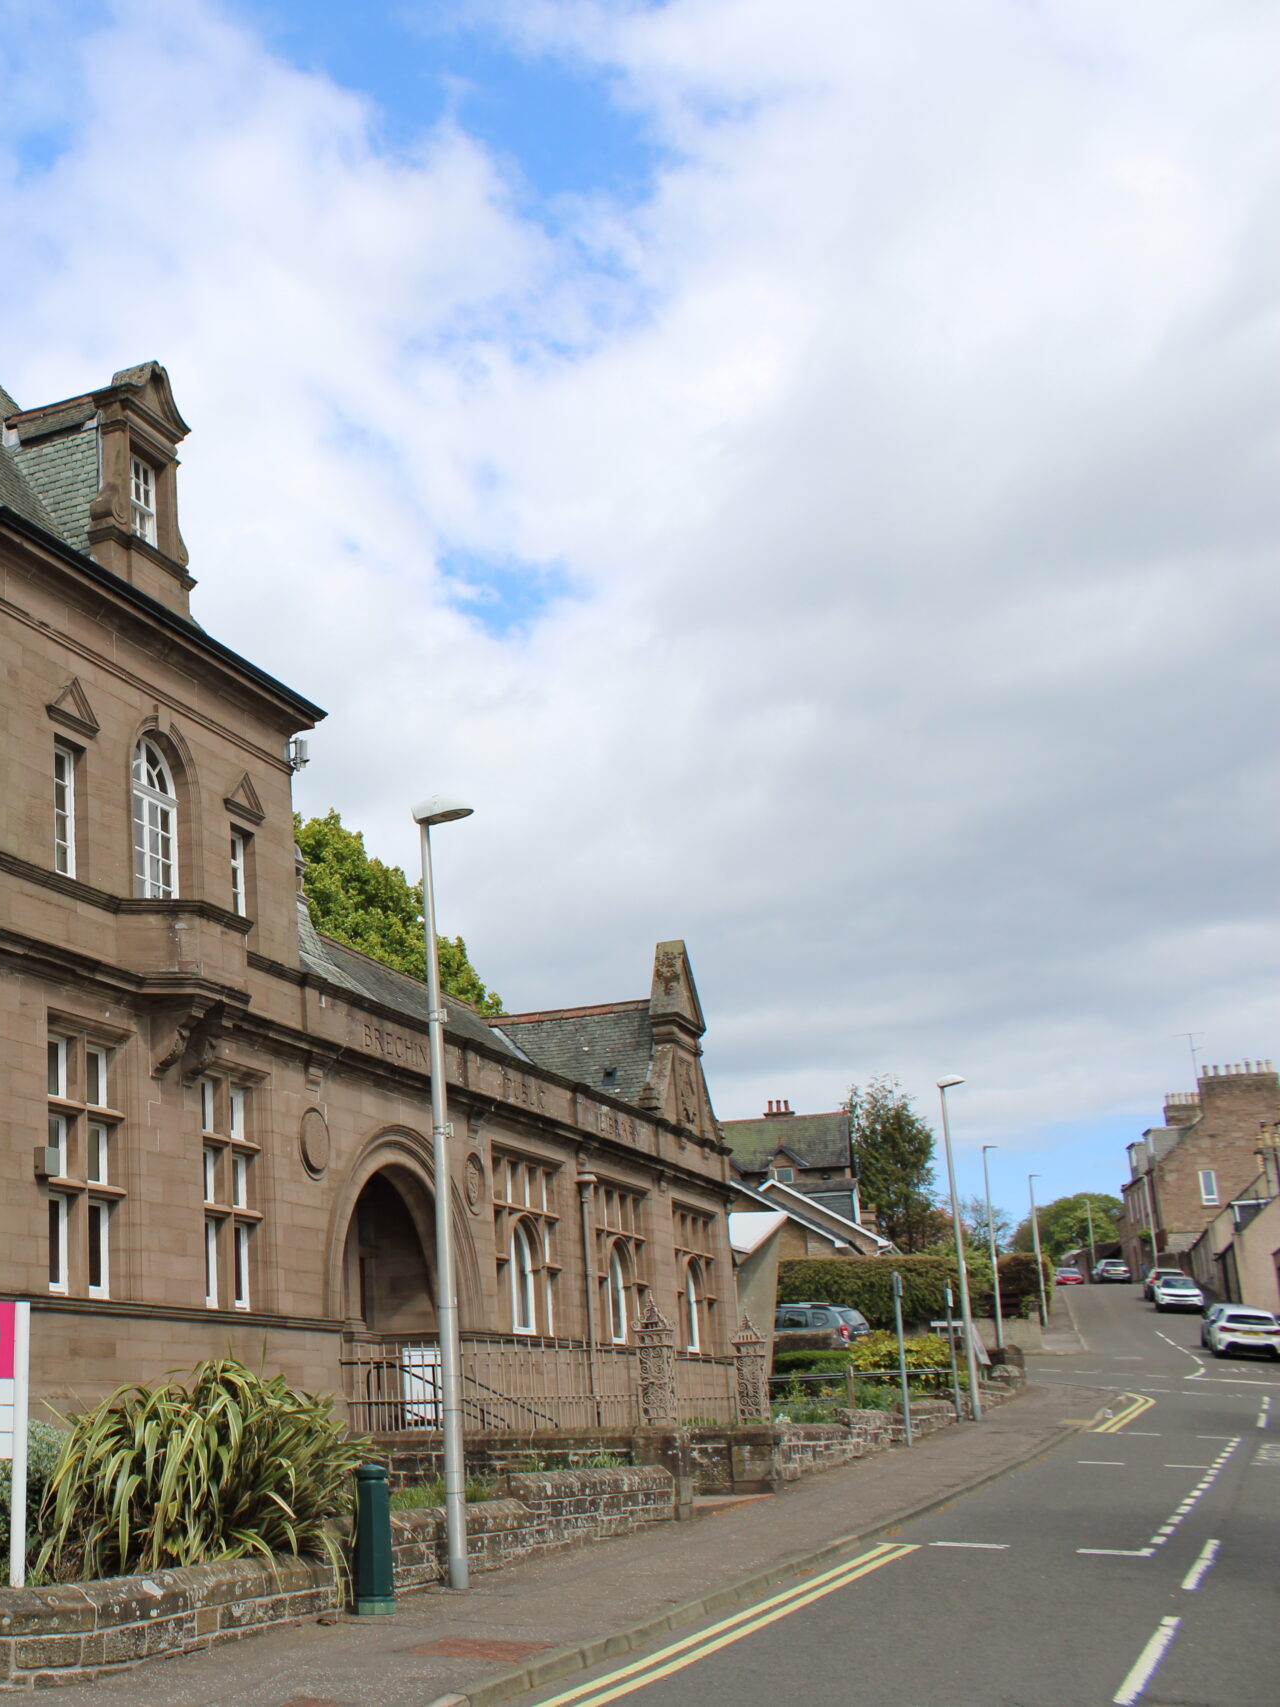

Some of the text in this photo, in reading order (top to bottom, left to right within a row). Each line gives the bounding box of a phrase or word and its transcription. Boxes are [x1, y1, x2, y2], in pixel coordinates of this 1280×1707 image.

[363, 1024, 640, 1146] BRECHIN PUBLIC LIBRARY
